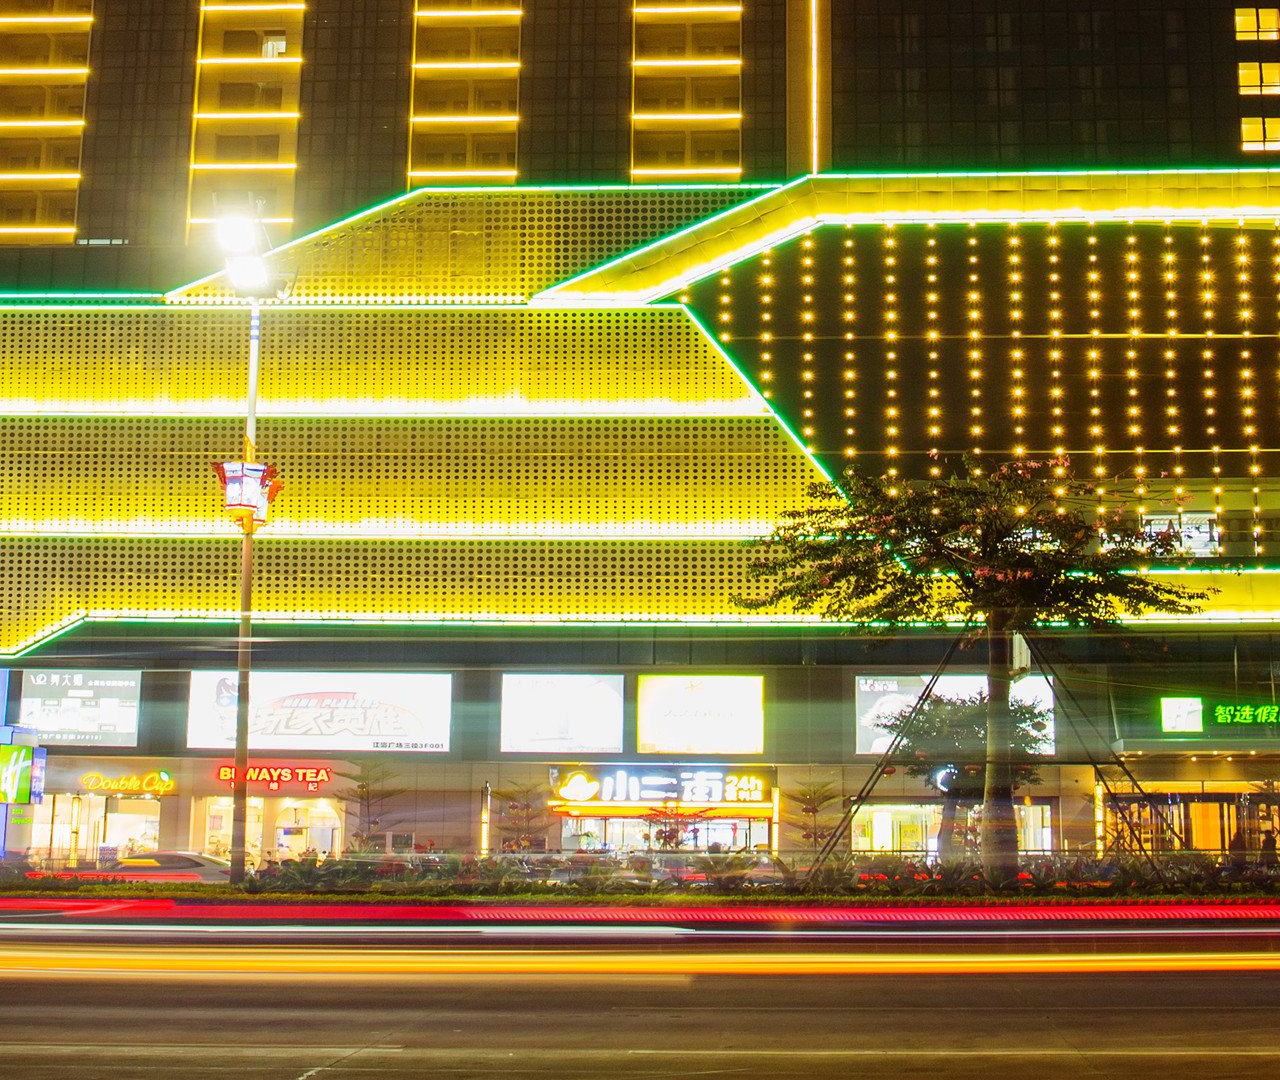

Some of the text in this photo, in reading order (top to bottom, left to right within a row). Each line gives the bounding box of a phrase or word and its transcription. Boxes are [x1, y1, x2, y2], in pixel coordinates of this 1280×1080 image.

[295, 768, 329, 782] TEA
[82, 772, 175, 795] Double Cup
[724, 776, 763, 791] 24h
